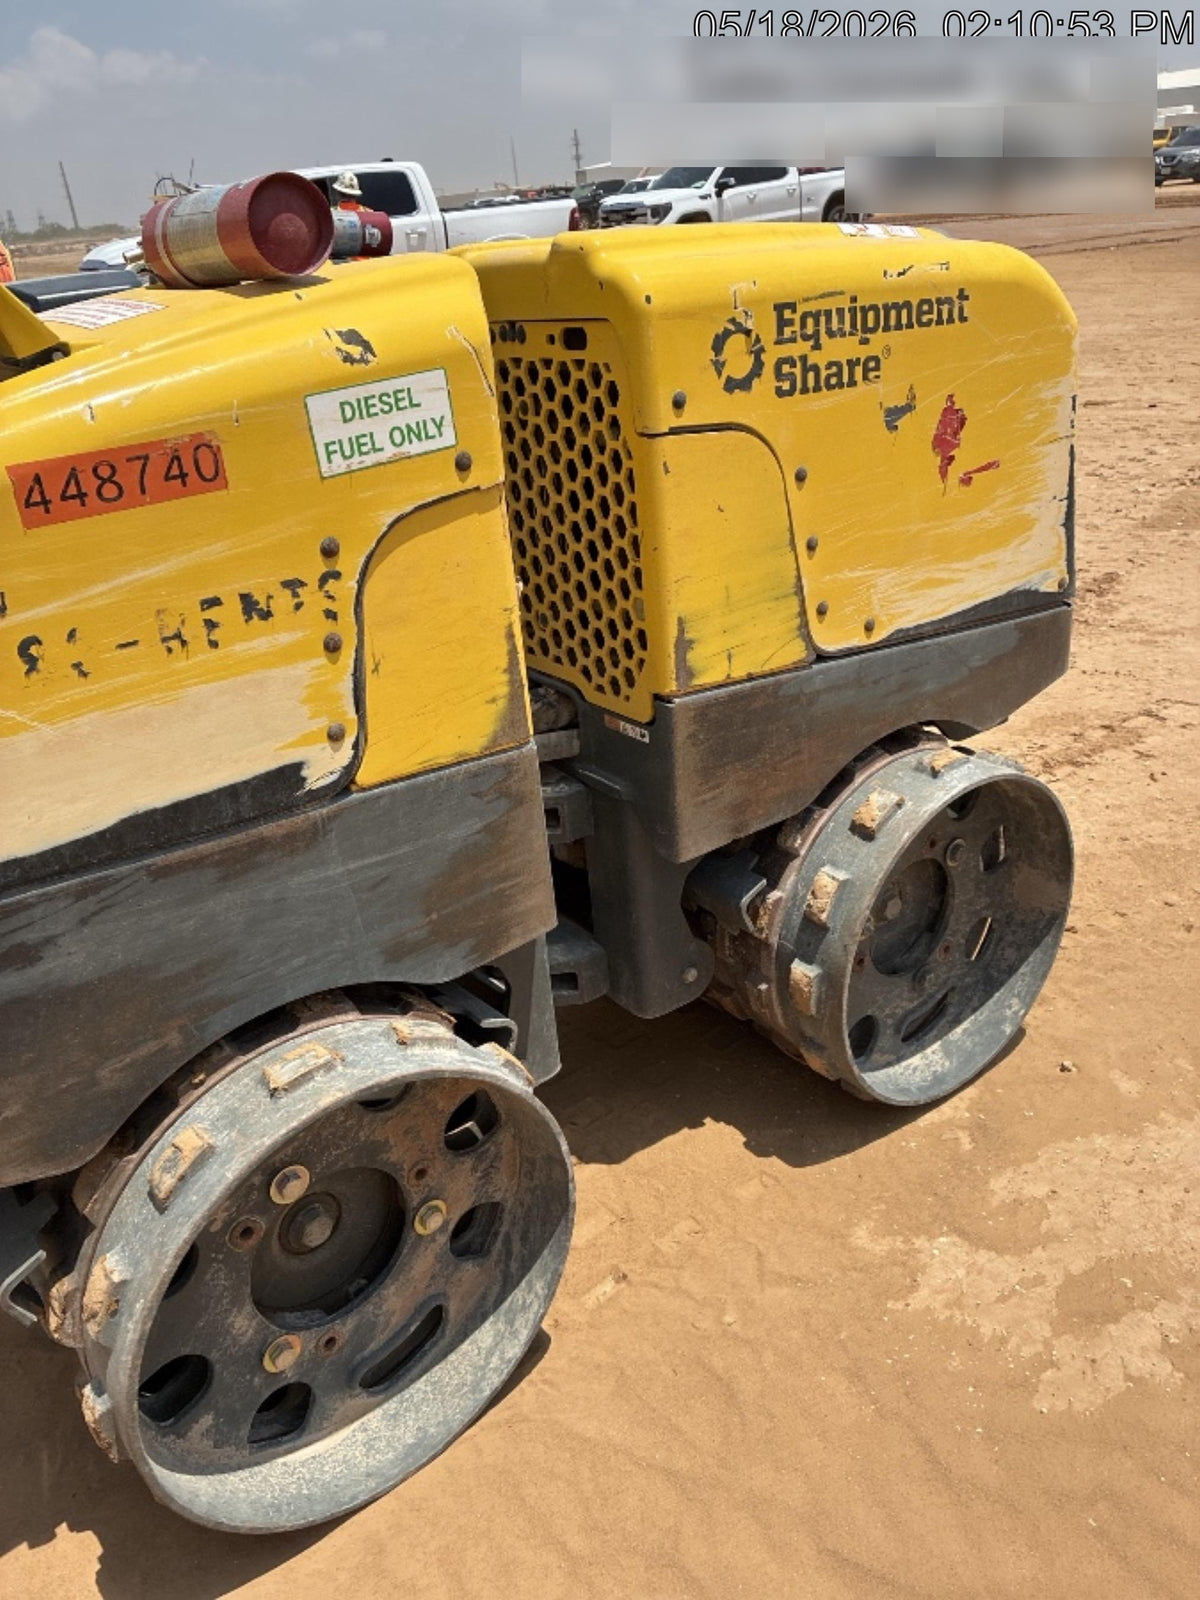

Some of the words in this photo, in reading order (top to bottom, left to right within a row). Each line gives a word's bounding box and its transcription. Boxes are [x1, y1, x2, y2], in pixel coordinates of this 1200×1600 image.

[773, 287, 970, 351] Equipment
[339, 387, 422, 424] DIESEL
[323, 431, 385, 465] FUEL
[388, 415, 445, 449] ONLY
[24, 442, 220, 514] 448740
